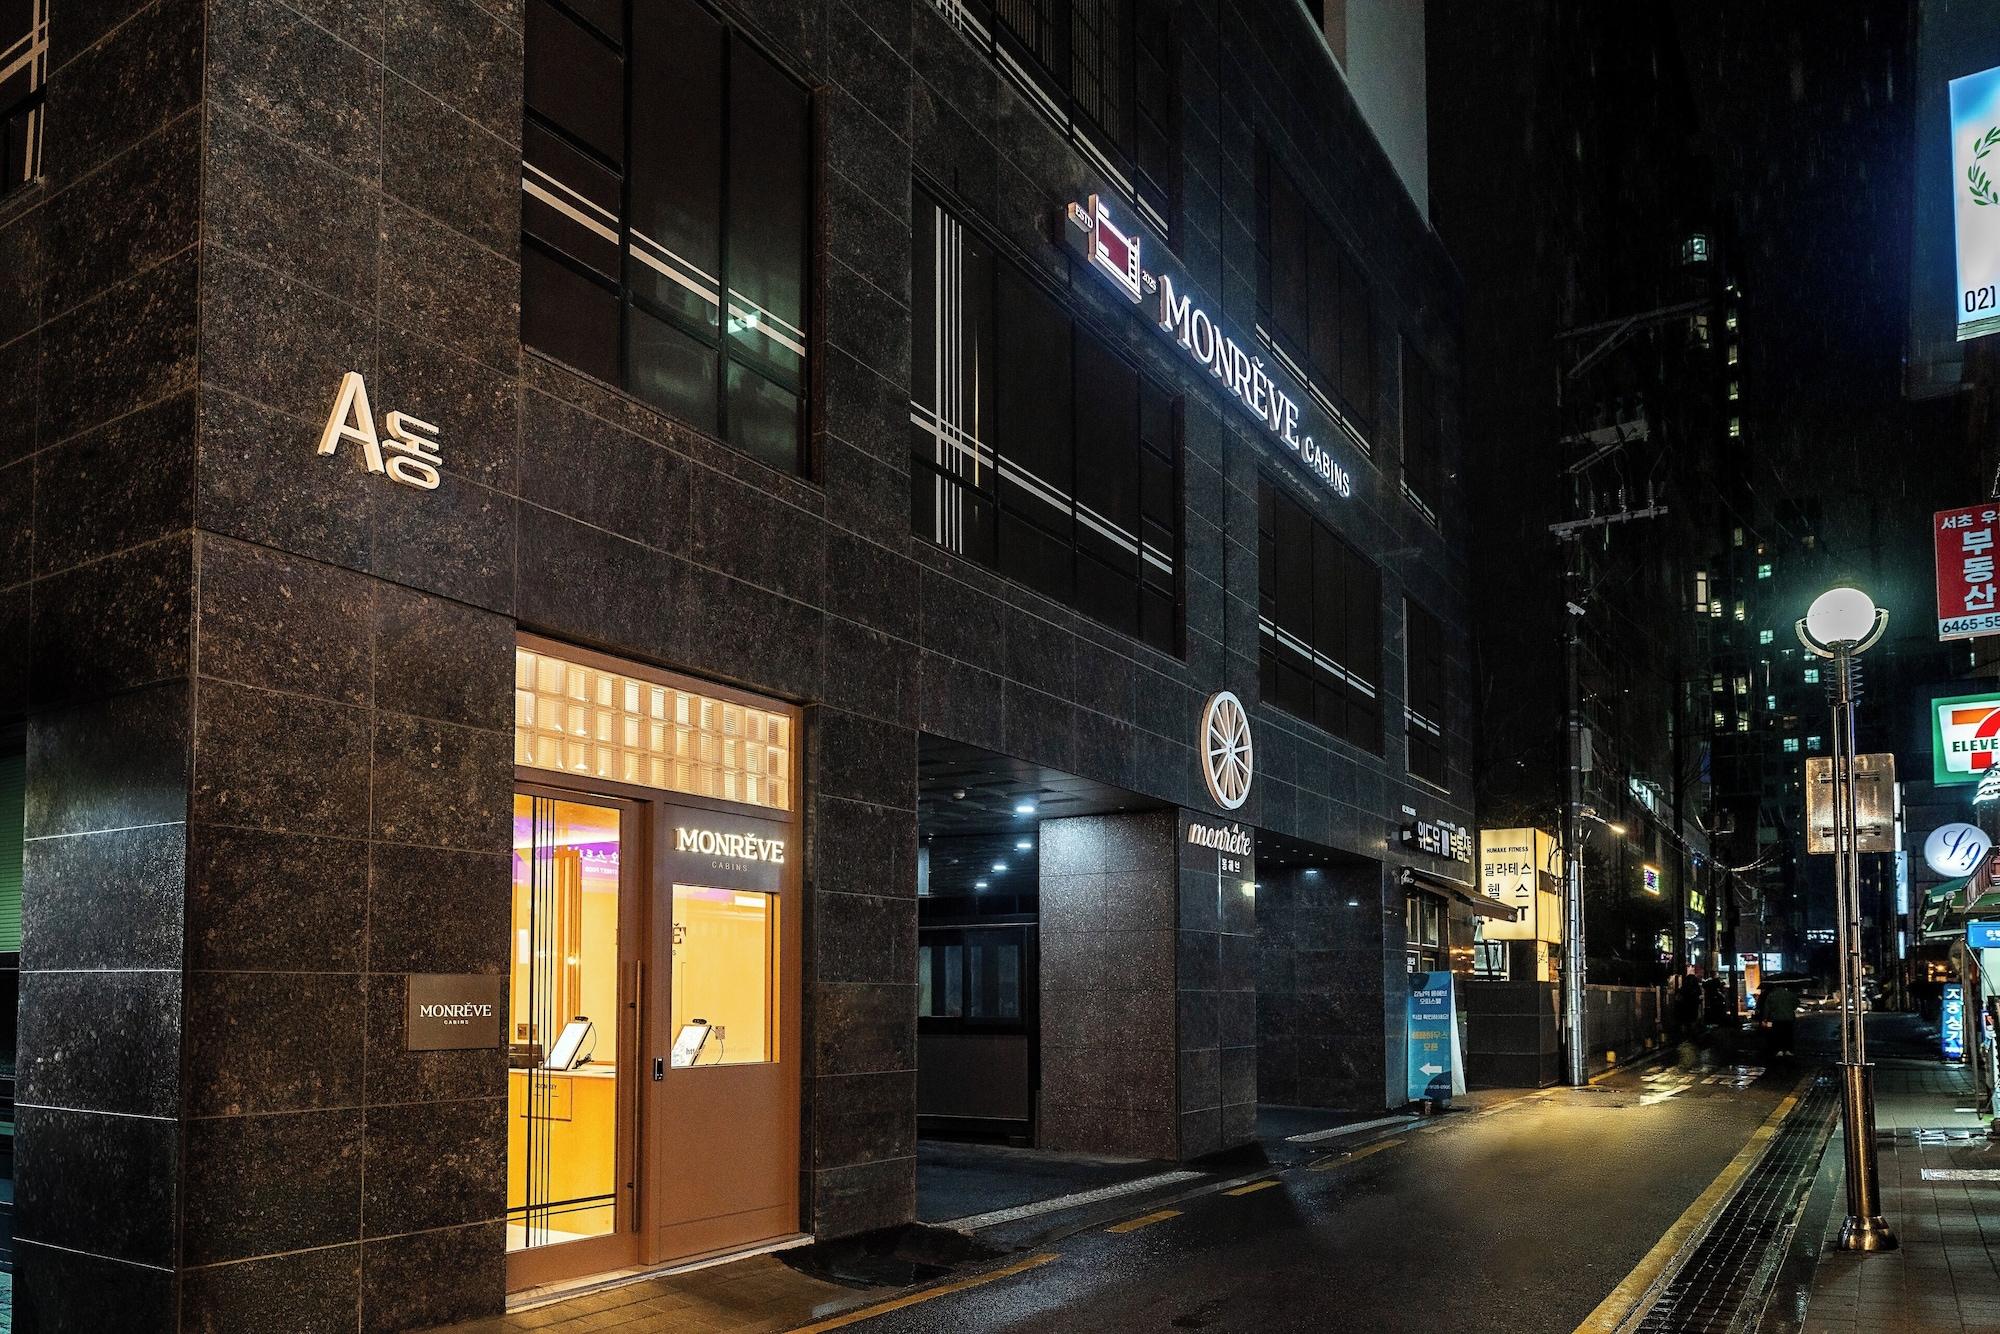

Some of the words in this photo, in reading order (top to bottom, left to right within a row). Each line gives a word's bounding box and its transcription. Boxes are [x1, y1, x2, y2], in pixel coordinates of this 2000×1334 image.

[1075, 204, 1093, 229] ESTD
[317, 371, 442, 490] A동
[1302, 437, 1349, 497] CABINS
[1941, 514, 1973, 529] 서초
[1962, 528, 1997, 611] 부동산
[1942, 615, 2000, 633] 6465-55
[1188, 823, 1251, 856] monrêve
[711, 861, 748, 872] CABINS
[1485, 862, 1531, 876] 필라테스
